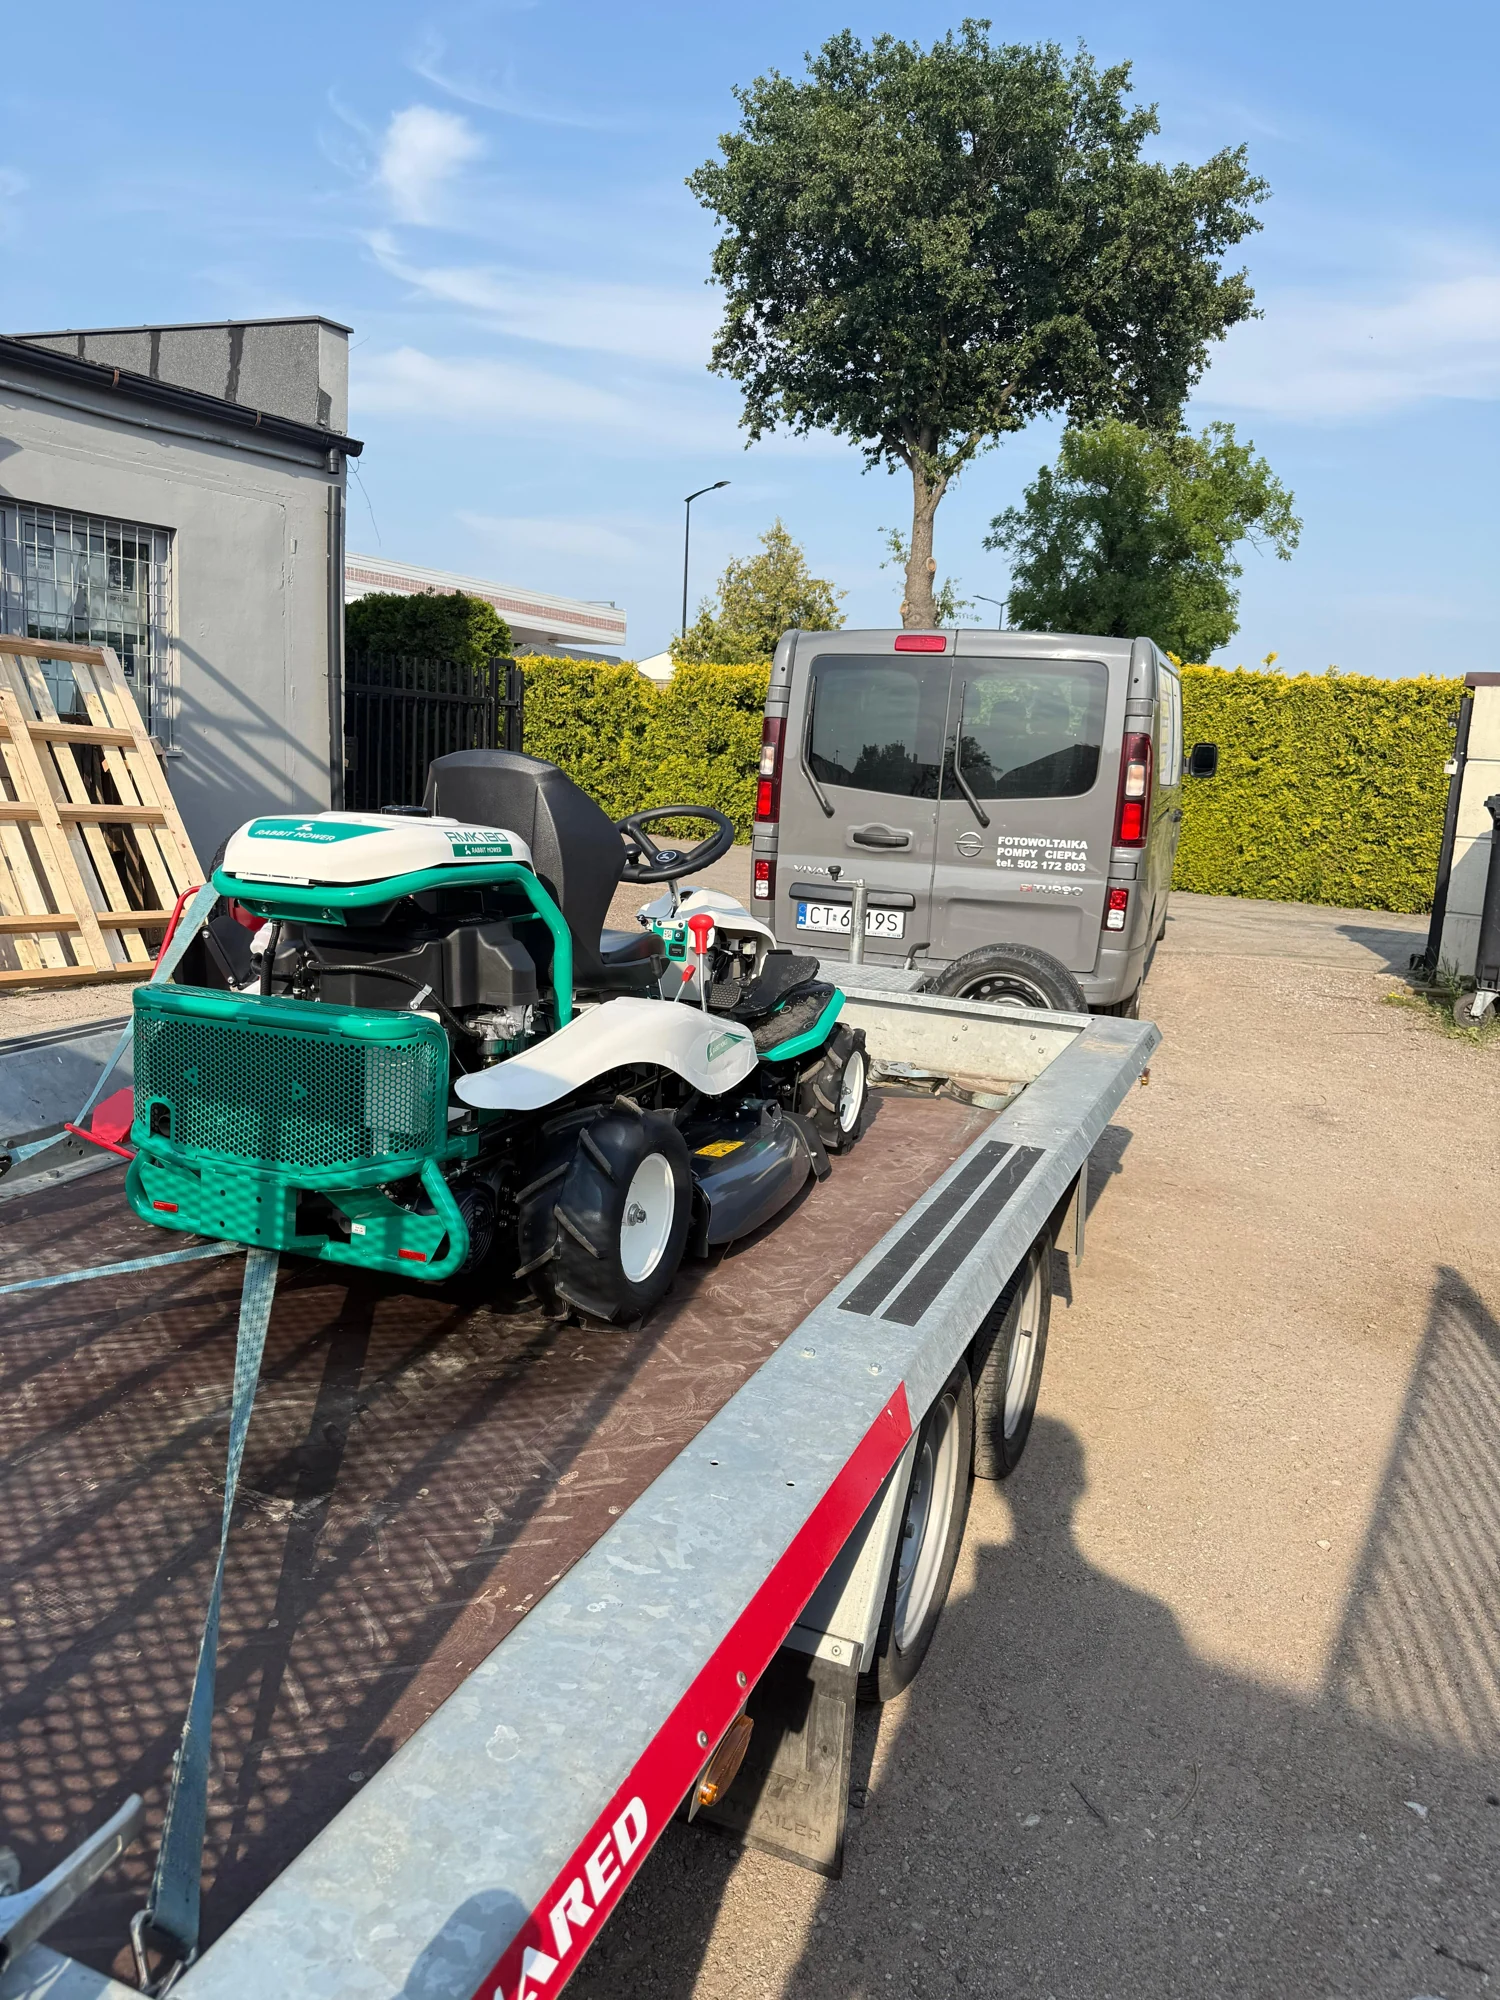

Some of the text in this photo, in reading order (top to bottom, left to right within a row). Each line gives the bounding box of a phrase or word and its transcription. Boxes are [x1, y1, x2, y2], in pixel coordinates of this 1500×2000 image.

[255, 829, 336, 841] RABBIT MOWER
[443, 831, 509, 842] RMK180
[997, 836, 1088, 849] FOTOWOLTAIKA
[997, 847, 1087, 861] POMPY CIEPŁA
[996, 858, 1086, 872] tel. 502 172 803
[810, 906, 898, 932] CT 619S
[493, 1796, 648, 2000] ARED
